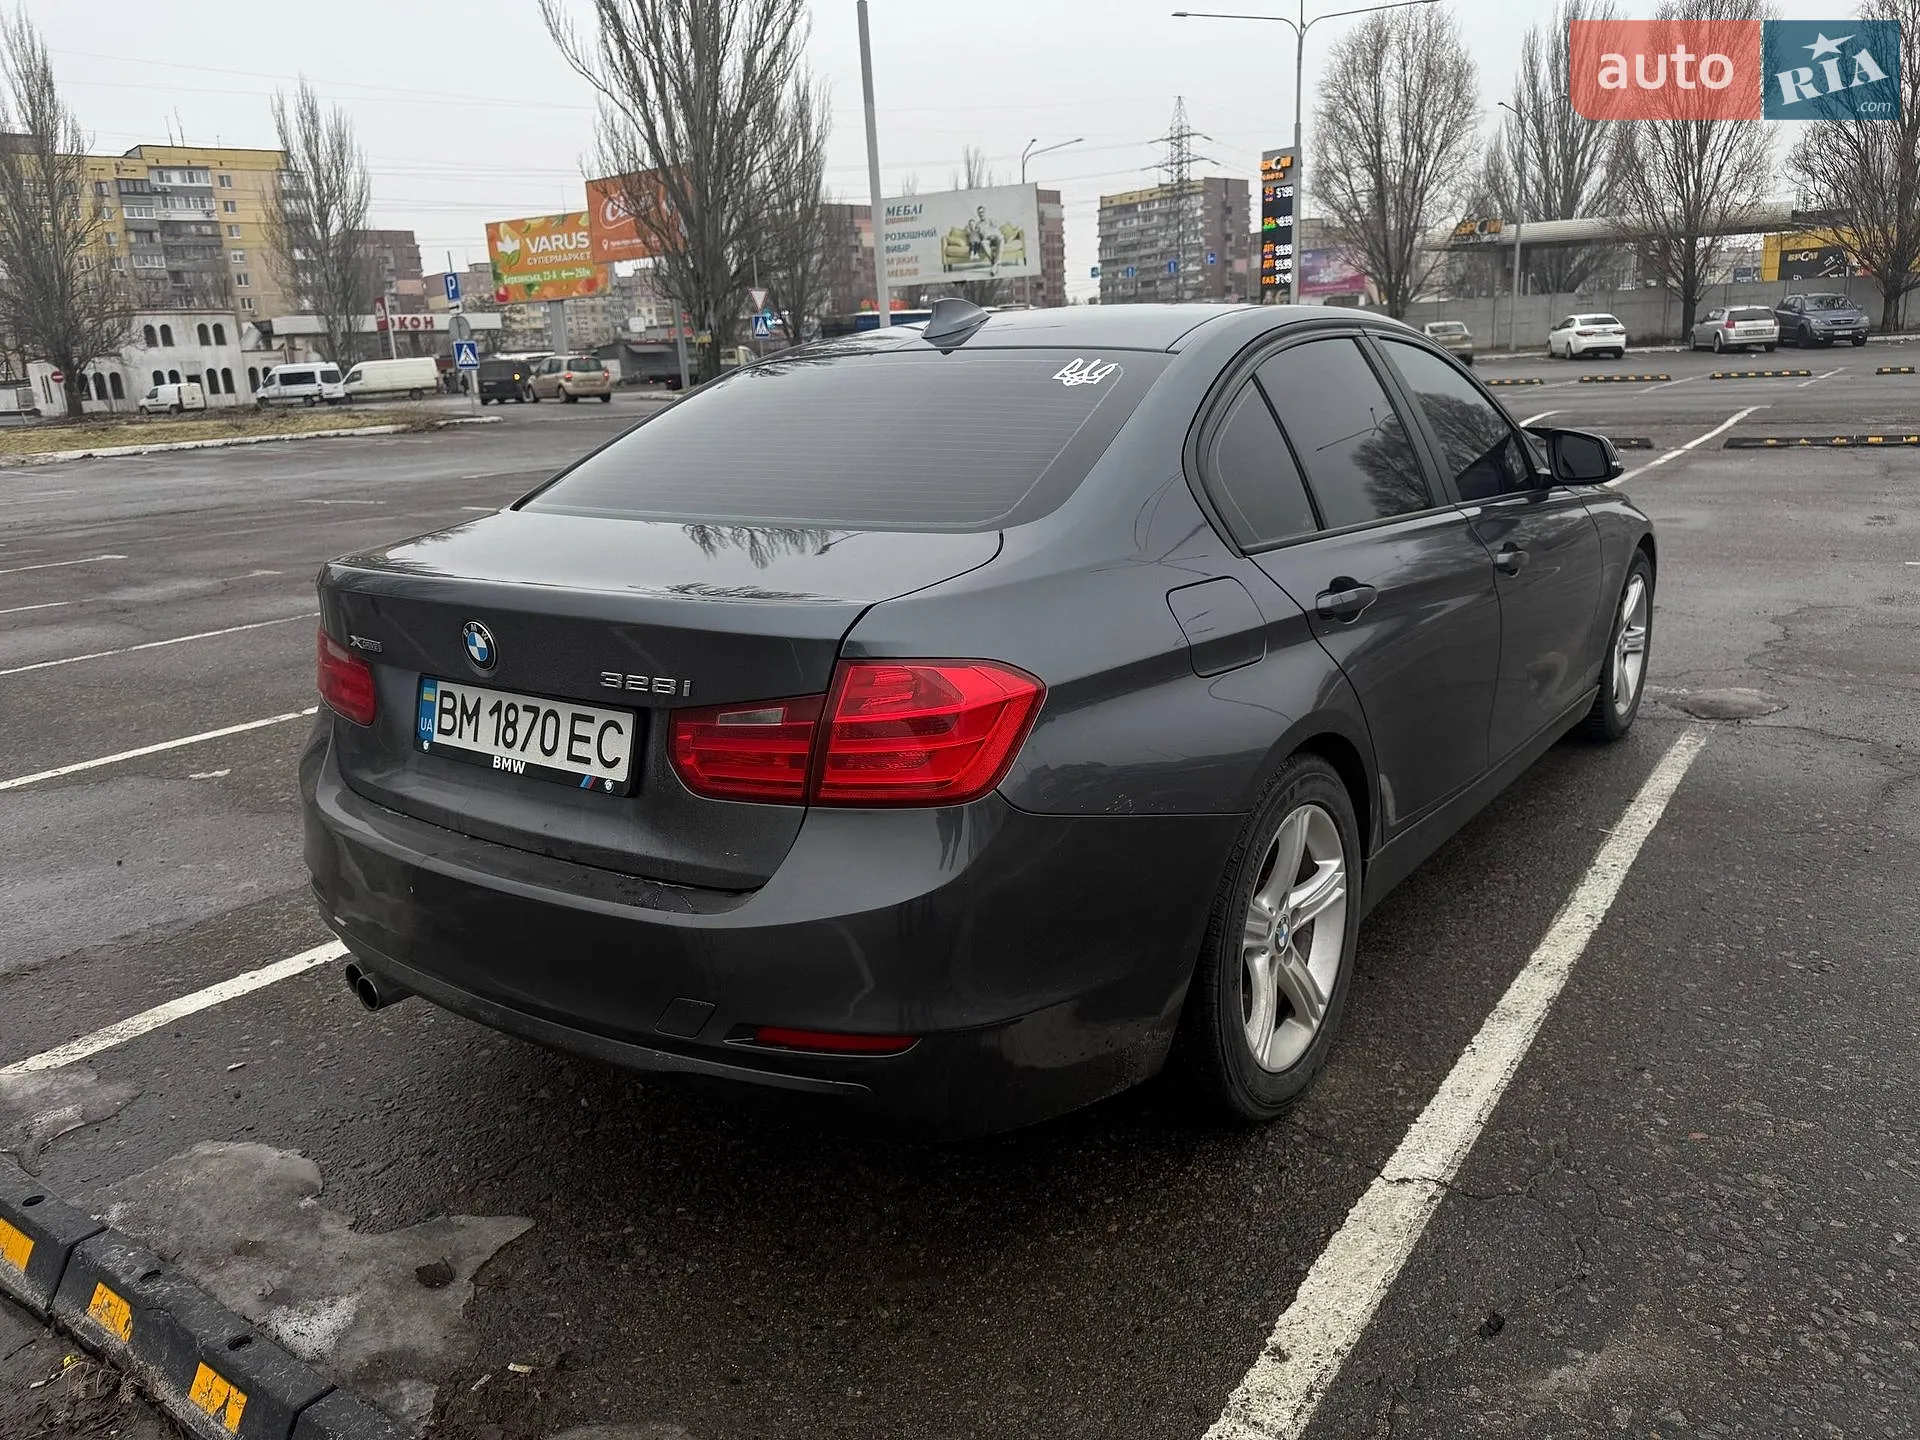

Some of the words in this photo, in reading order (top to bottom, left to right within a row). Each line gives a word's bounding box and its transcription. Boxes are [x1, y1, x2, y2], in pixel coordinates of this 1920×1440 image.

[526, 231, 590, 254] VARUS
[527, 251, 592, 266] СУПЕРМАРКЕТ
[600, 671, 692, 697] 328i
[420, 717, 433, 733] UA
[437, 689, 481, 743] BM
[488, 700, 561, 757] 1870
[566, 712, 624, 769] EC
[492, 755, 526, 775] BMW
